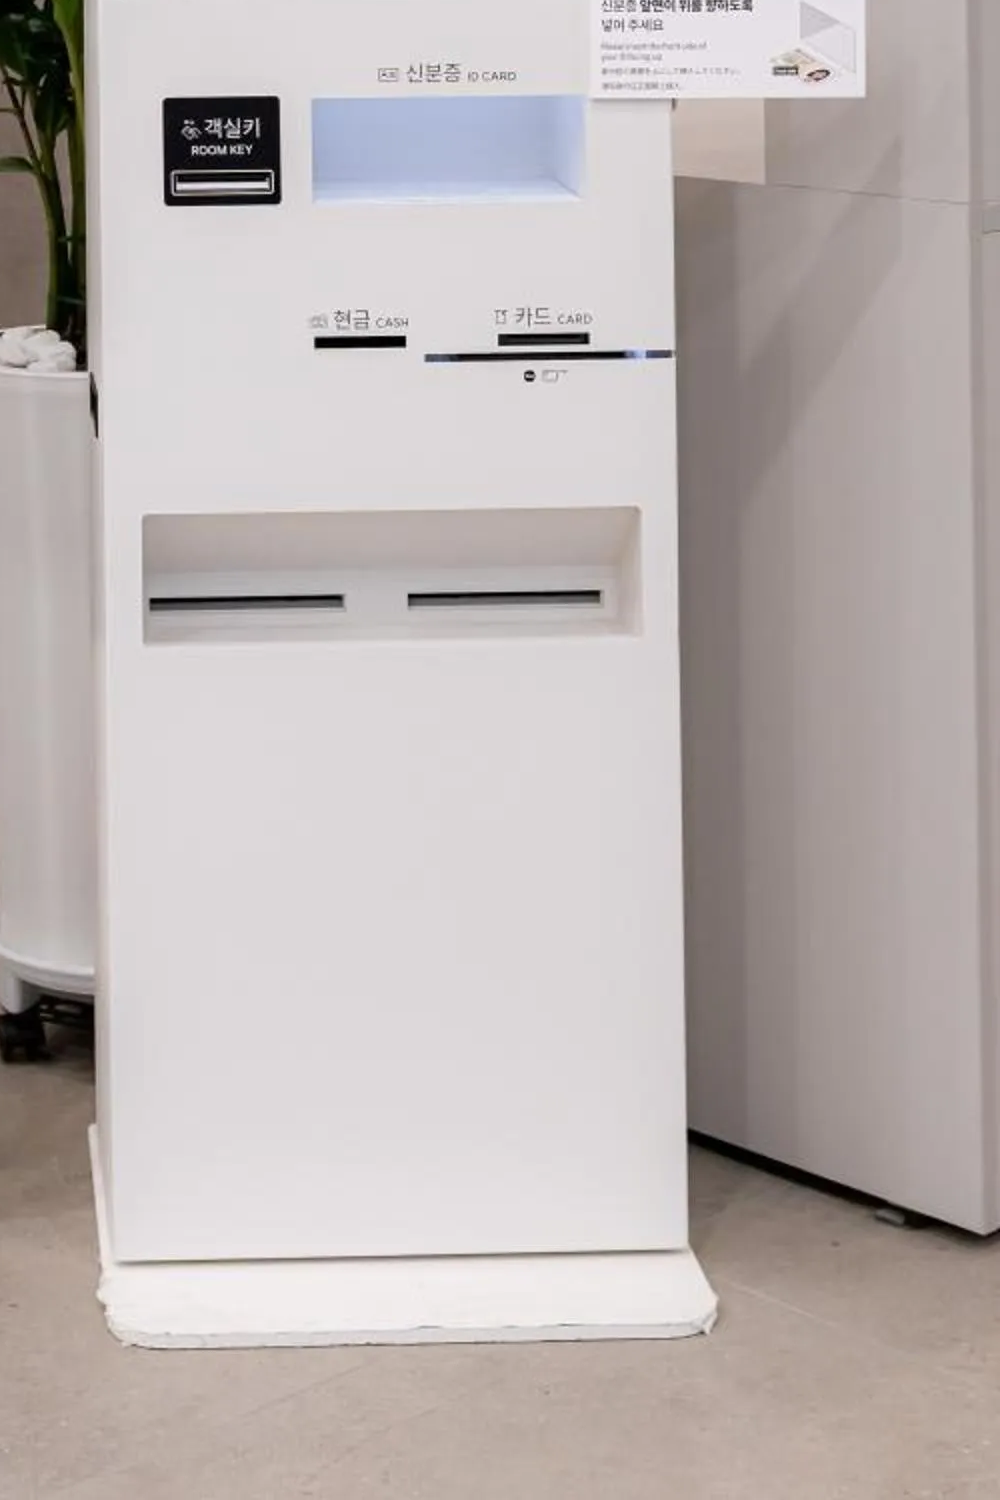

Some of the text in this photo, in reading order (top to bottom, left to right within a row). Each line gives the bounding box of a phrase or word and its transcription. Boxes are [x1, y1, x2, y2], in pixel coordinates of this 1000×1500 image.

[406, 63, 461, 83] 신분증
[482, 71, 516, 81] CARD
[204, 117, 261, 139] 객실키
[192, 144, 253, 155] ROOM KEY
[333, 309, 409, 331] 현금 CASH
[515, 307, 592, 326] 카드 CARD
